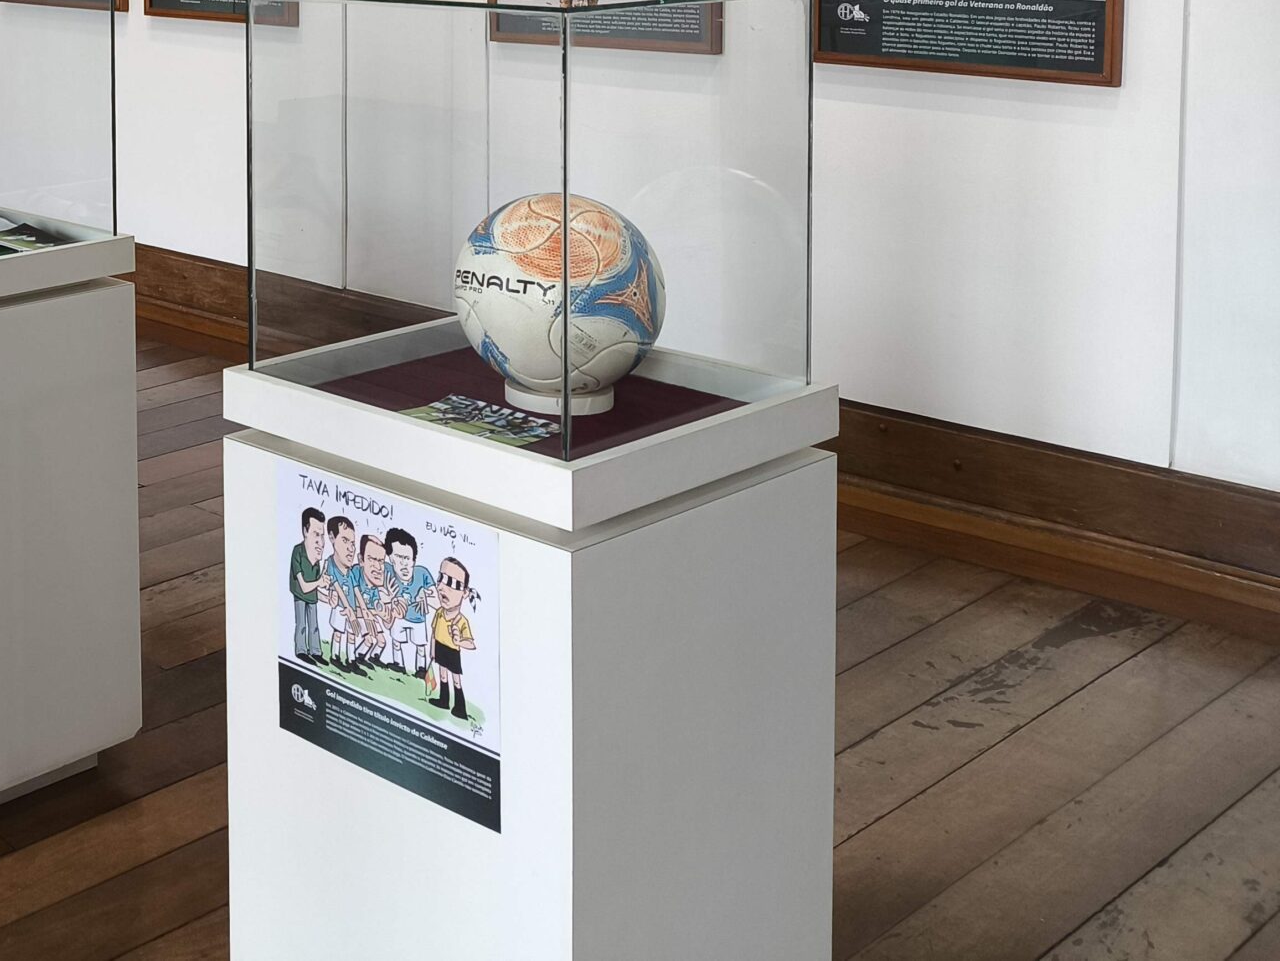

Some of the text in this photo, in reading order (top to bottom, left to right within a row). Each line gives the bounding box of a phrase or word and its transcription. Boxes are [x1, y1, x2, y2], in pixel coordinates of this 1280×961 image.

[945, 0, 957, 8] gol
[969, 1, 1003, 9] Veterana
[1016, 2, 1054, 11] Ronaldão
[455, 269, 556, 297] PENALTY
[299, 474, 393, 520] TAVA IMPEDIDO!
[426, 521, 436, 533] EU
[440, 525, 456, 539] NÃO
[325, 689, 336, 699] Gol
[363, 706, 373, 716] tira
[374, 710, 389, 723] título
[411, 728, 419, 737] da
[420, 732, 448, 750] Caldense
